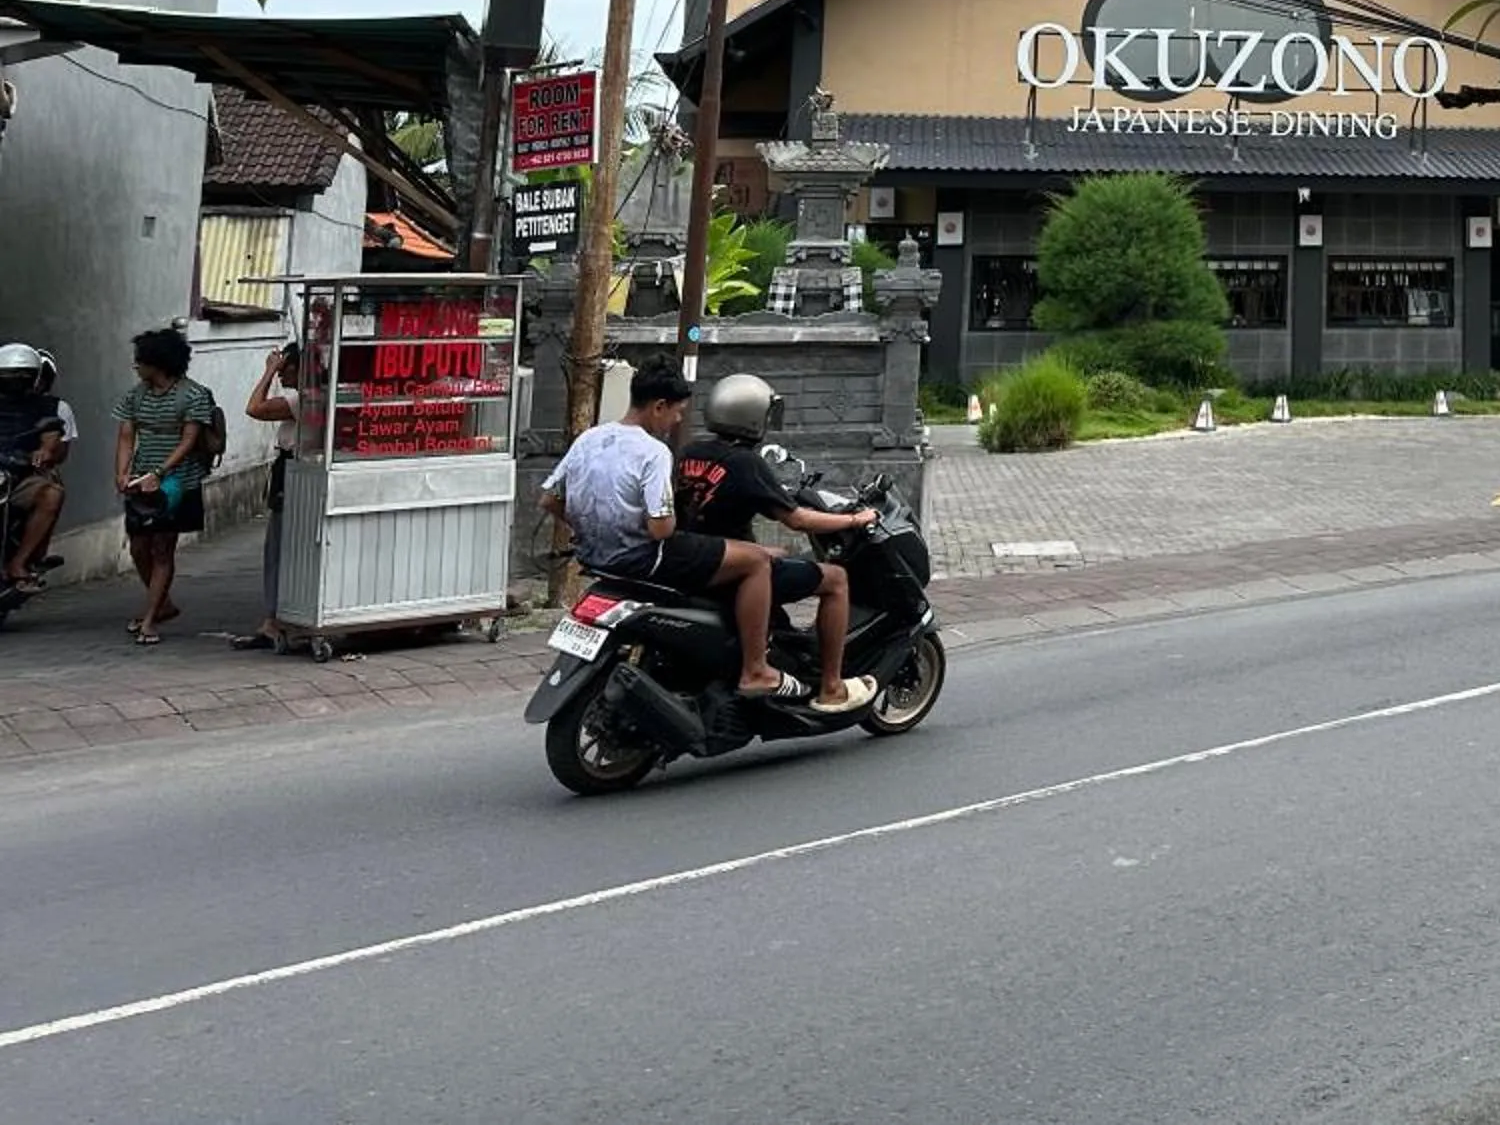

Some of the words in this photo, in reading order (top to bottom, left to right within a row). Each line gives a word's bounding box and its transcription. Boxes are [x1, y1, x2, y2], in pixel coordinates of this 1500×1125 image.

[1017, 23, 1448, 98] OKUZONO
[528, 83, 580, 111] ROOM
[518, 116, 547, 138] FOR
[550, 107, 591, 135] RENT
[1067, 106, 1251, 136] JAPANESE
[1270, 111, 1398, 140] DINING
[515, 190, 541, 213] BALE
[541, 186, 576, 210] SUBAK
[515, 212, 577, 238] PETITENGET
[374, 343, 415, 379] IBU
[422, 342, 481, 378] PUTU
[358, 420, 410, 437] Lawar
[412, 419, 460, 436] Ayam
